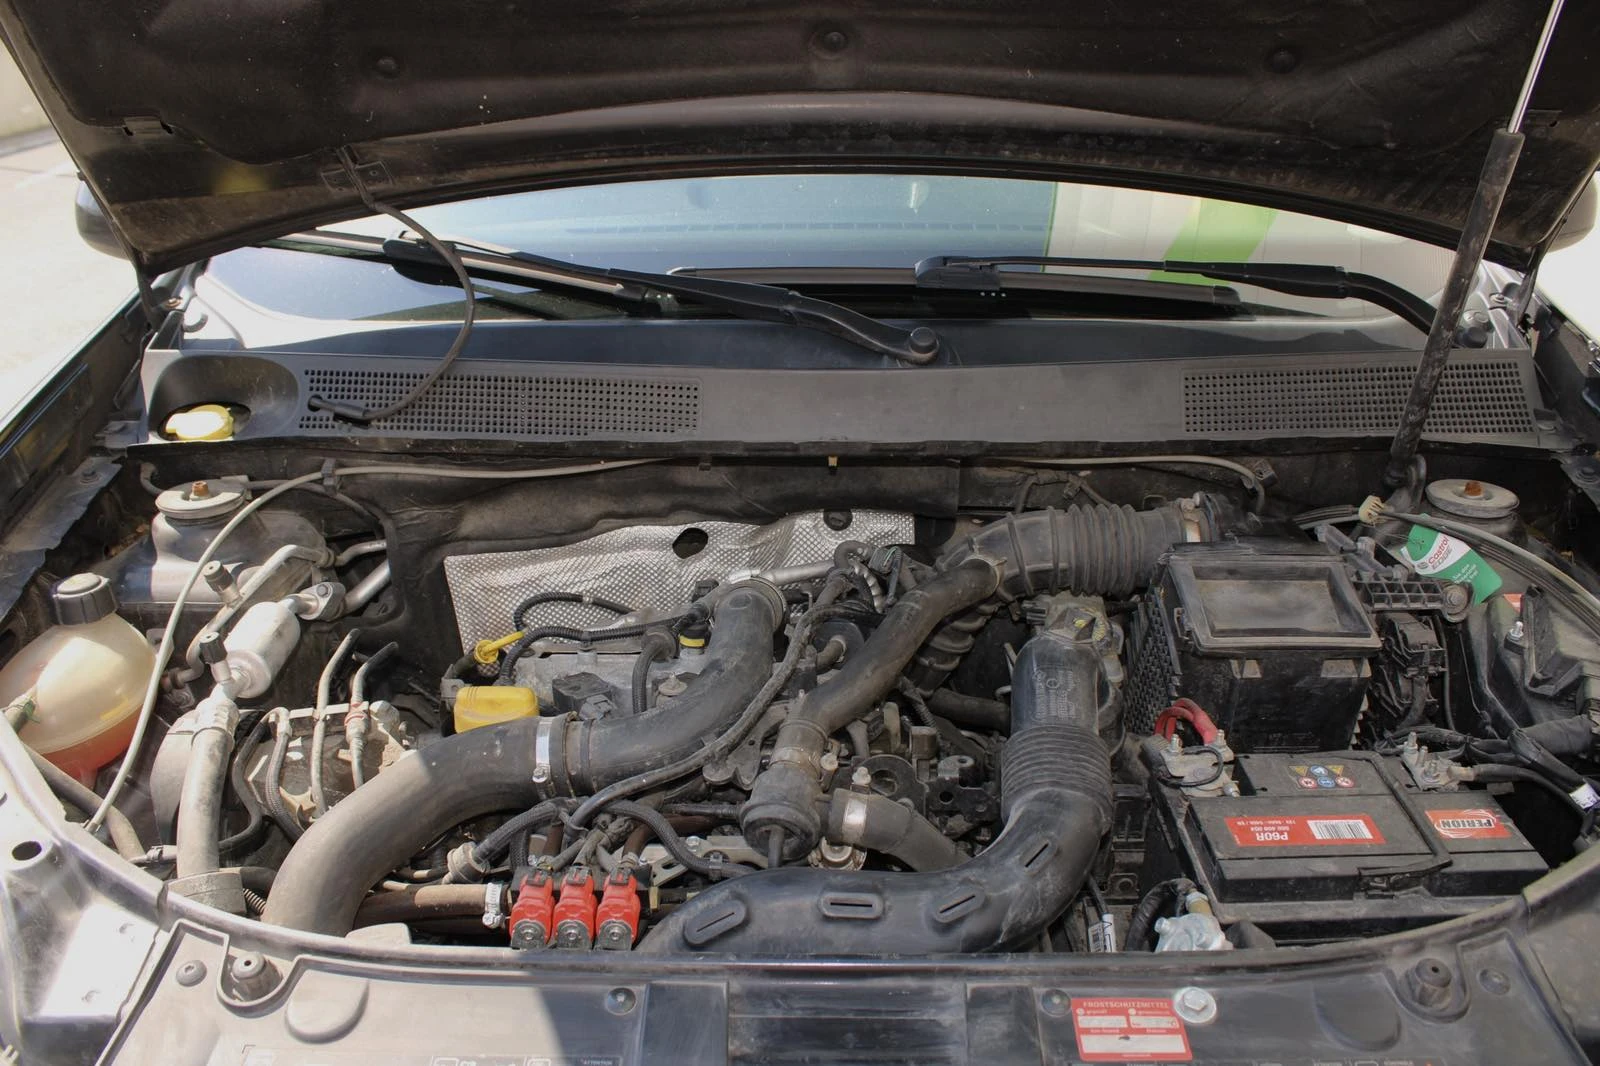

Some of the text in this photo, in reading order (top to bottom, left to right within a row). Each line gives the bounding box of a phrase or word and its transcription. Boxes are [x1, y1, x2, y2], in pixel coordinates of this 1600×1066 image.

[1428, 536, 1450, 564] Castrol
[1440, 819, 1494, 828] PERION
[1256, 832, 1289, 841] P60R
[1083, 1000, 1169, 1008] FROSTSCHUTZMITTEL
